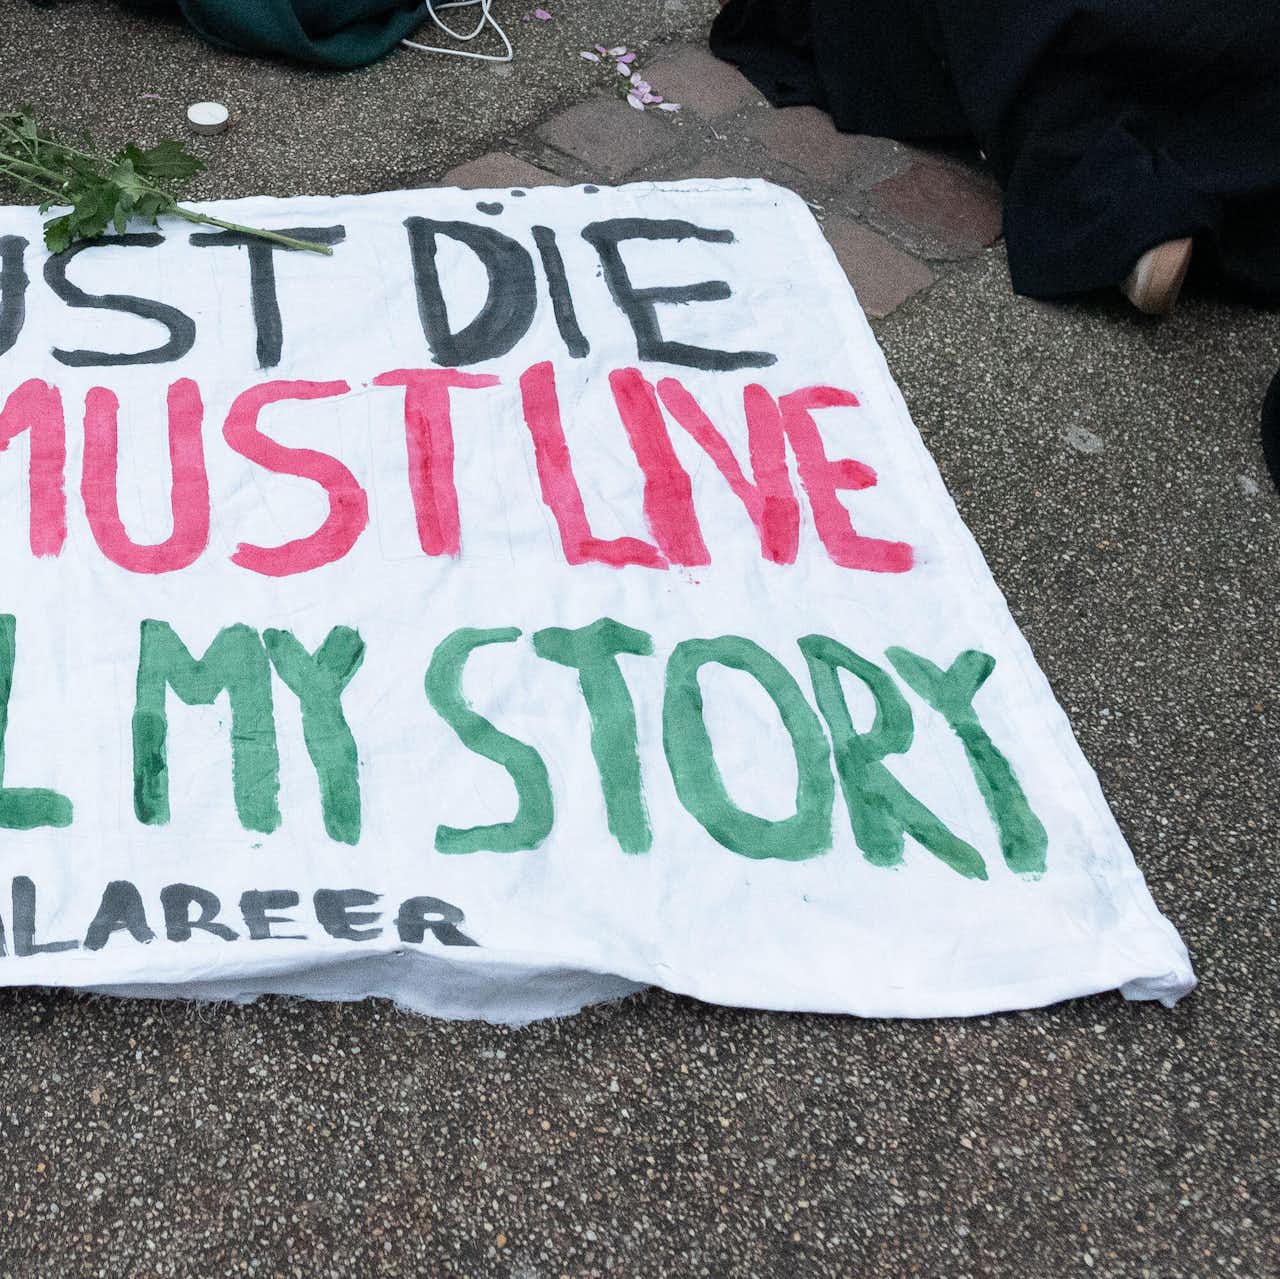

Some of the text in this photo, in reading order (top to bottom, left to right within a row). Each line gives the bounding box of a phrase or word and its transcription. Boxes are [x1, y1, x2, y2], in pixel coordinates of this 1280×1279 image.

[403, 216, 777, 372] DIE
[132, 618, 366, 846] MY
[424, 617, 1049, 880] STORY
